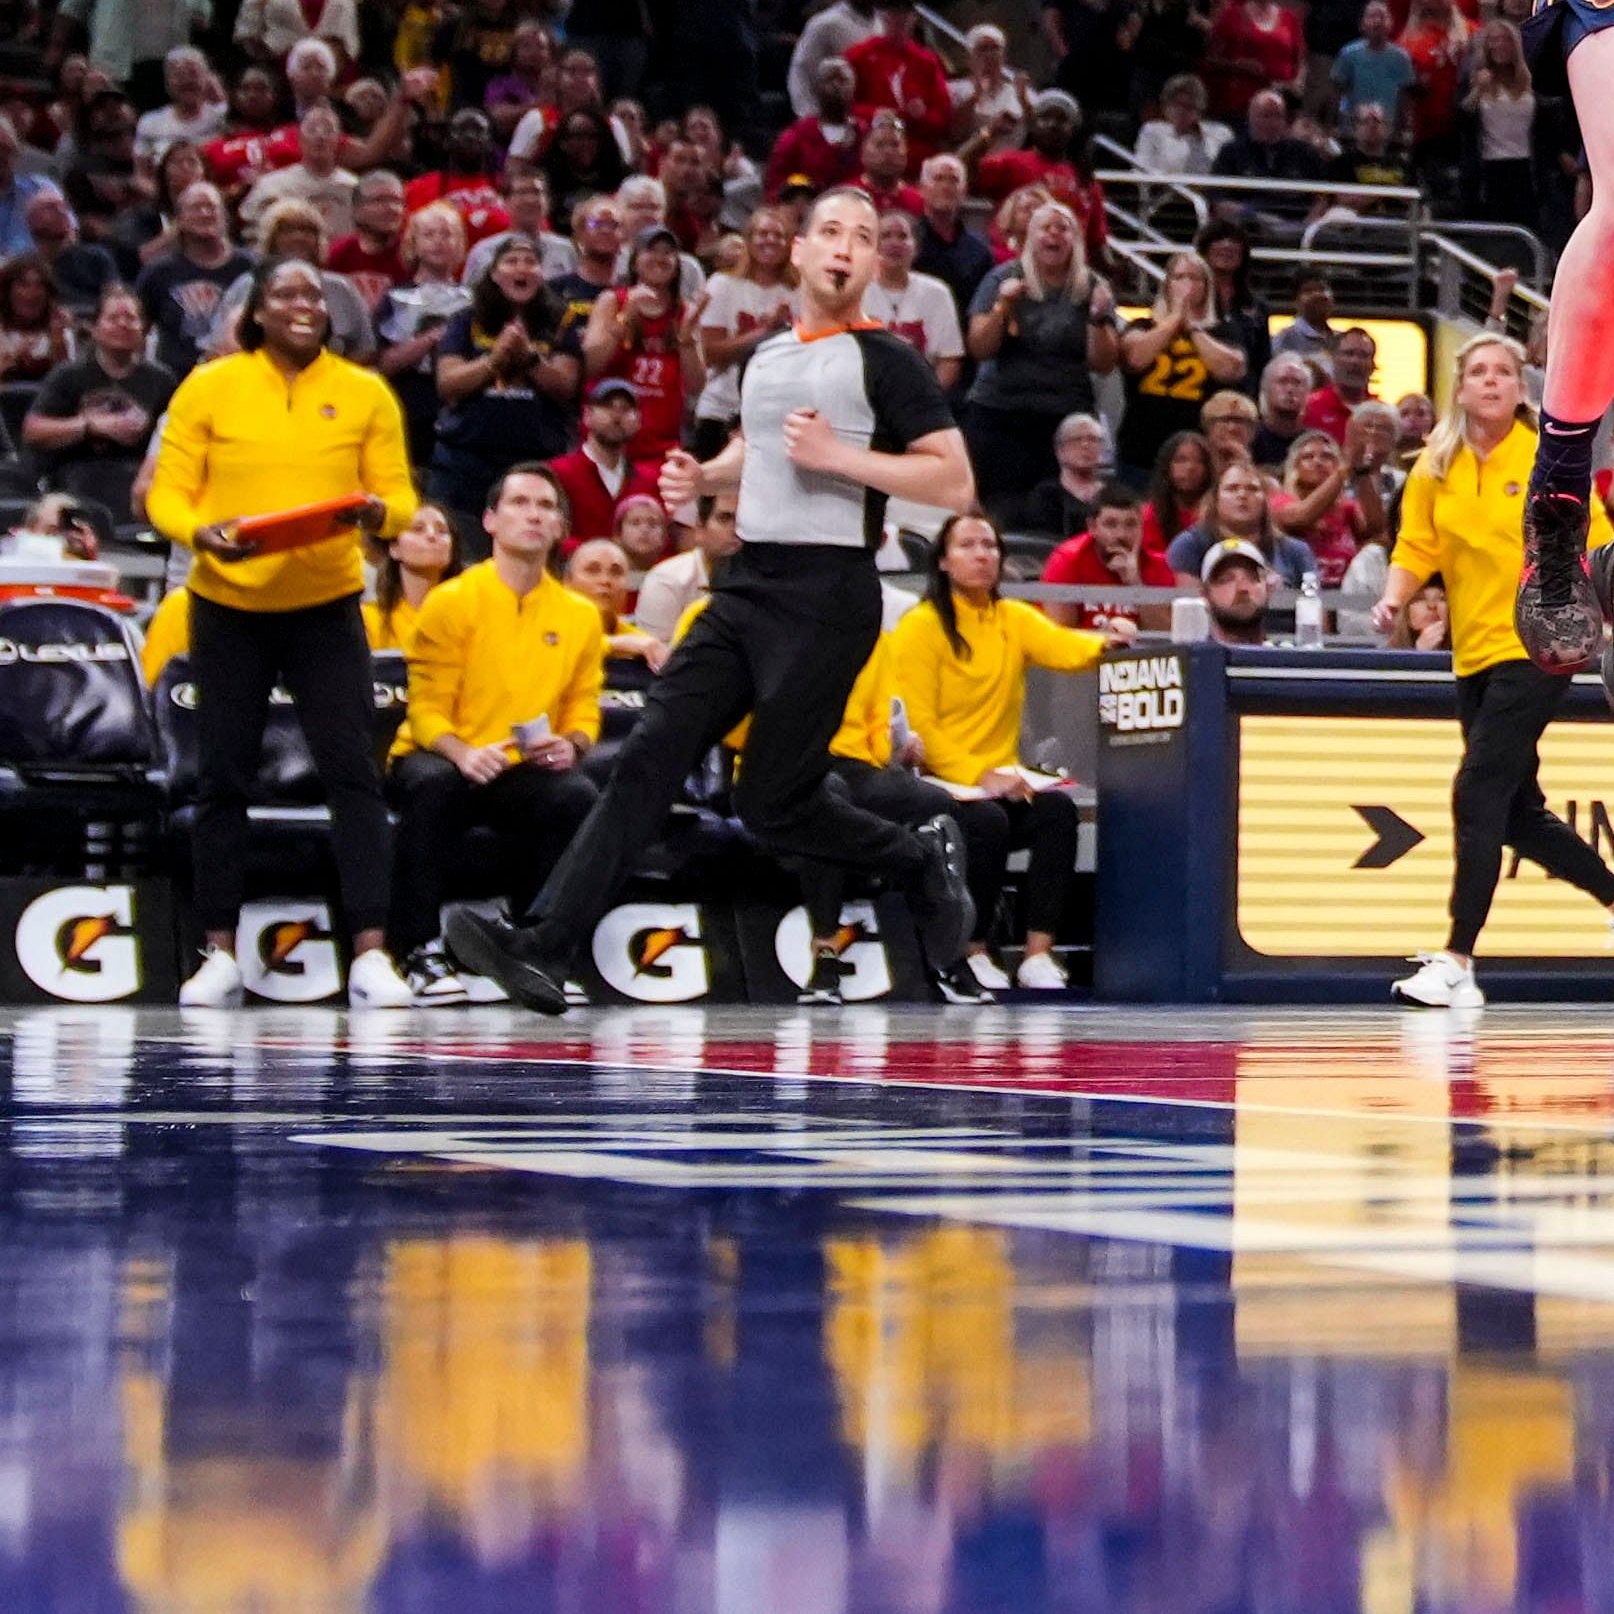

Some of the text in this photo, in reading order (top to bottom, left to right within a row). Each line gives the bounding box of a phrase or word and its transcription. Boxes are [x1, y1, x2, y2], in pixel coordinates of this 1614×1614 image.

[1138, 353, 1208, 402] 22
[1117, 688, 1185, 731] BOLD
[15, 884, 138, 1002] G
[238, 903, 354, 1002] G
[593, 903, 712, 1002] G
